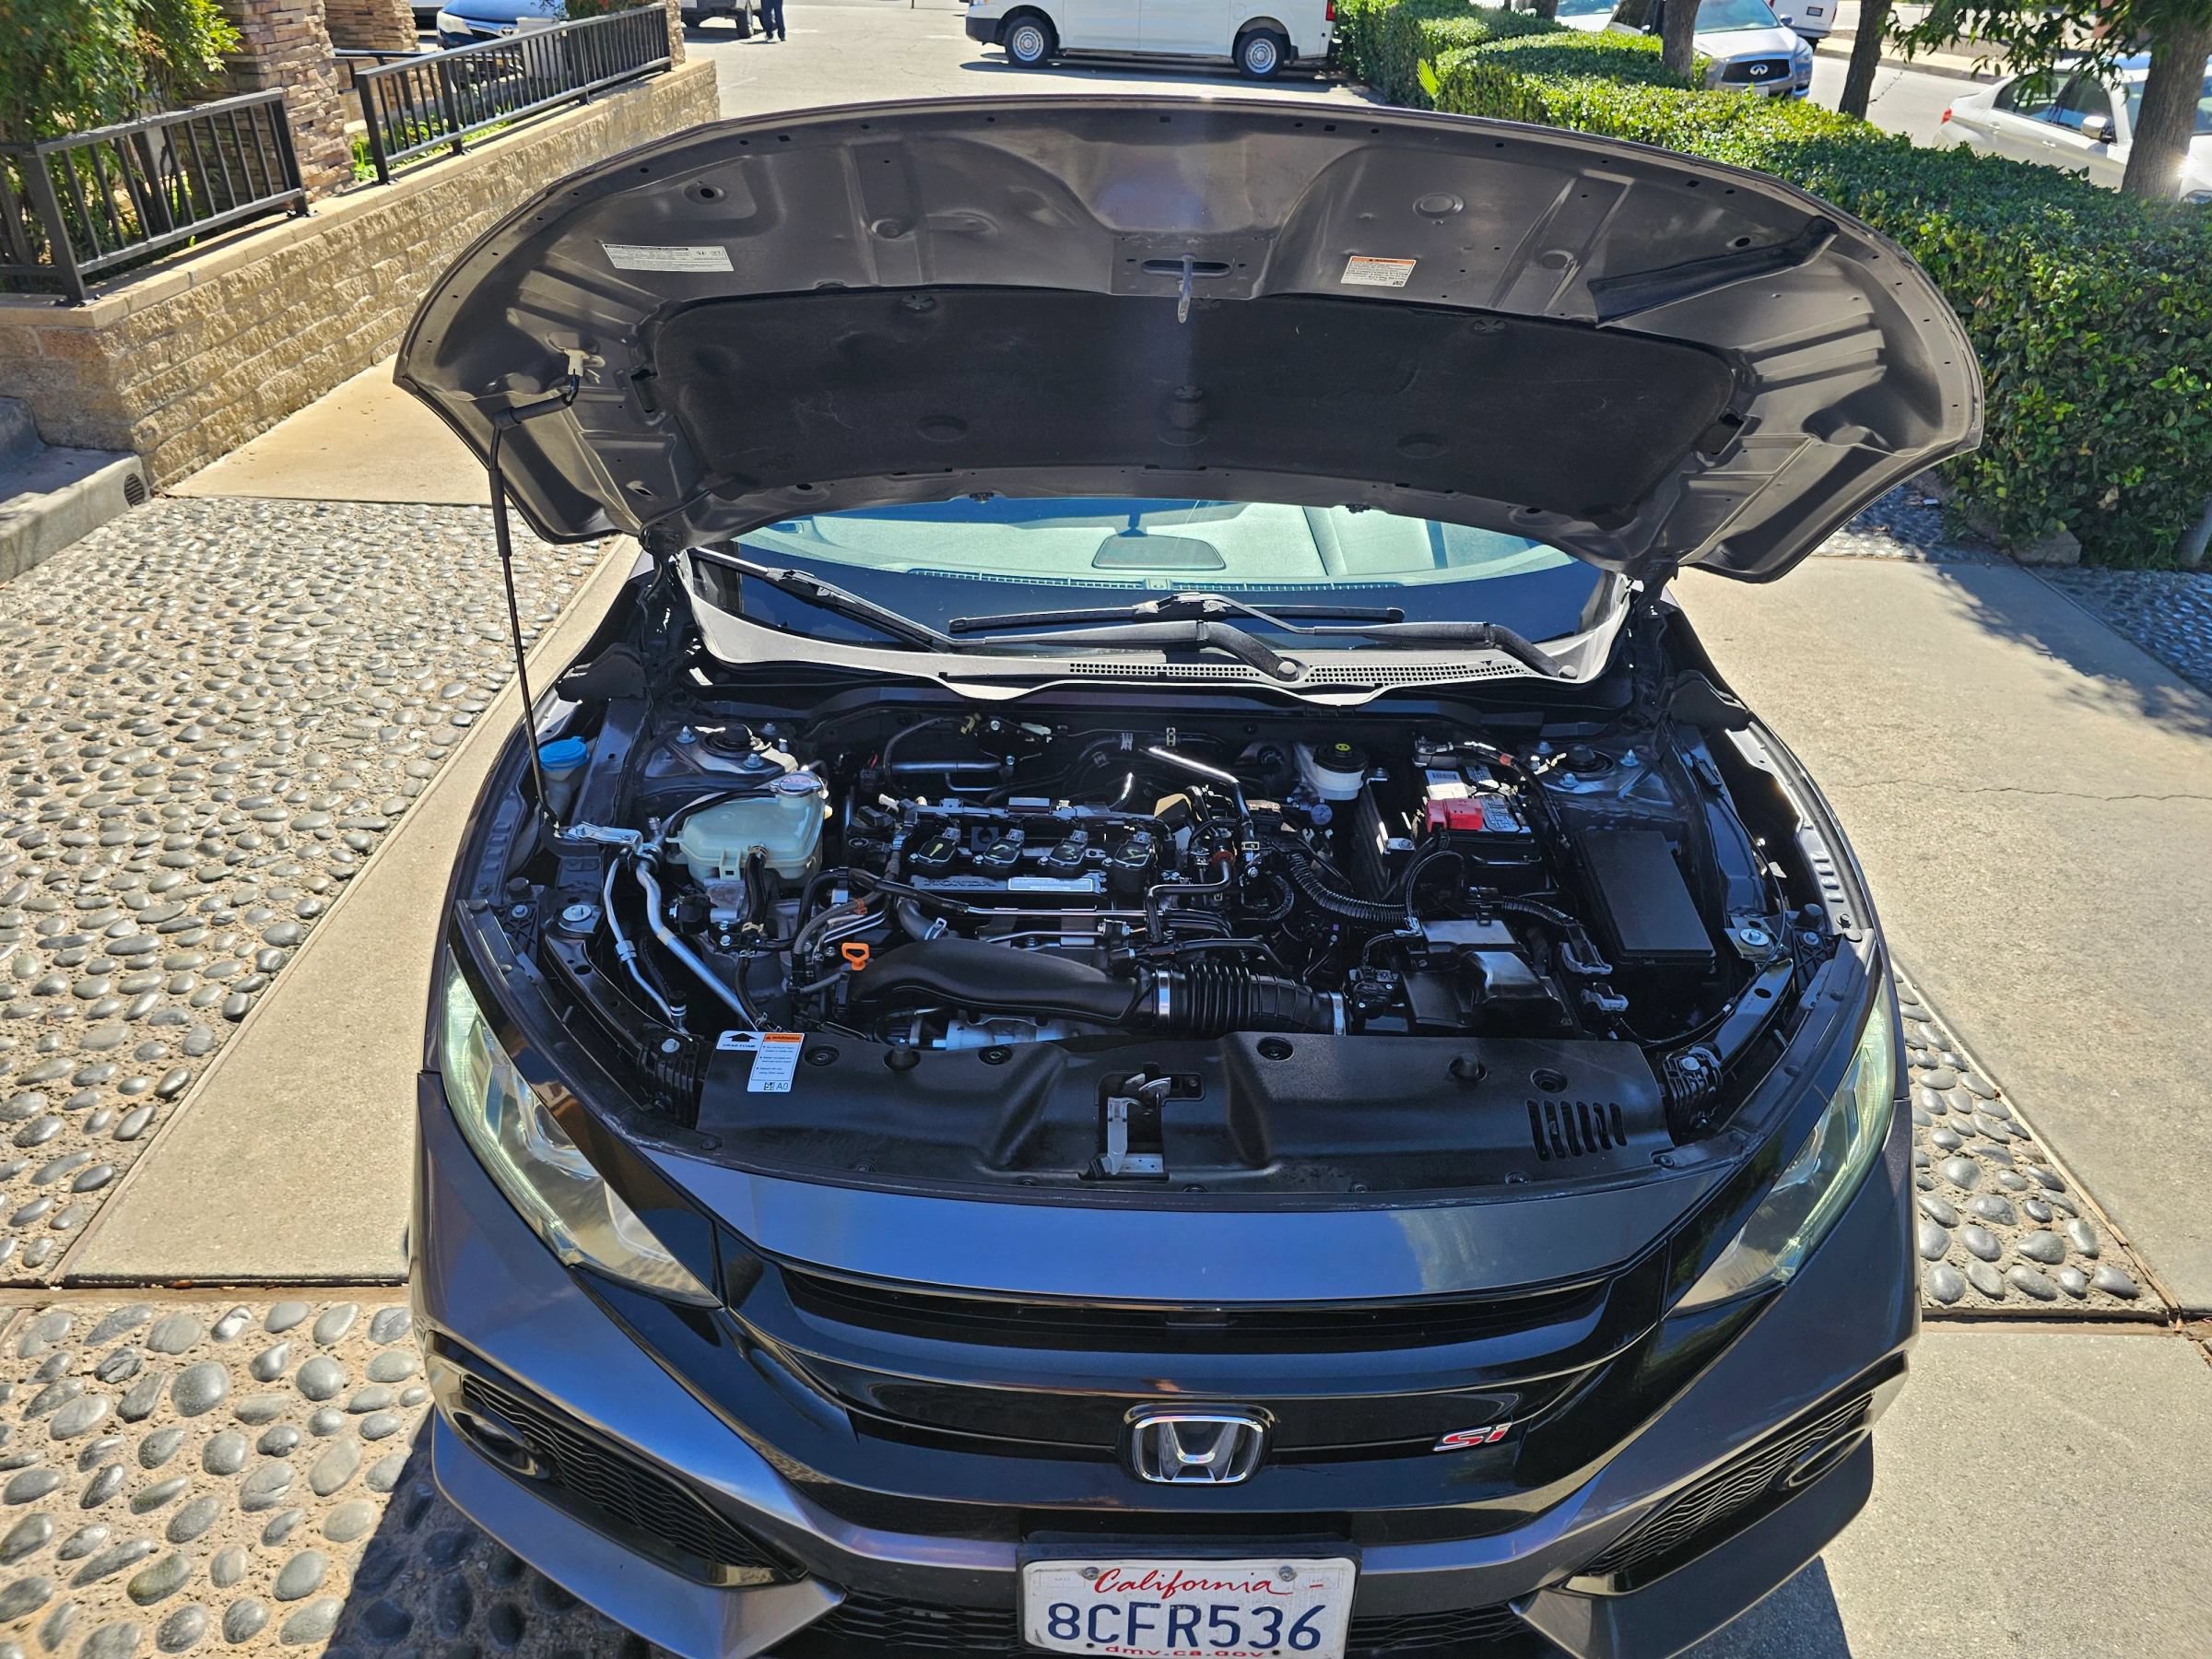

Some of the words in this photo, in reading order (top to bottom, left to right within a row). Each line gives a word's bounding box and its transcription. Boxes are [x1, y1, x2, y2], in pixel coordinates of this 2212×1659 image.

[1434, 1422, 1512, 1452] Si
[1094, 1568, 1293, 1599] California
[1047, 1601, 1326, 1652] 8CFR536
